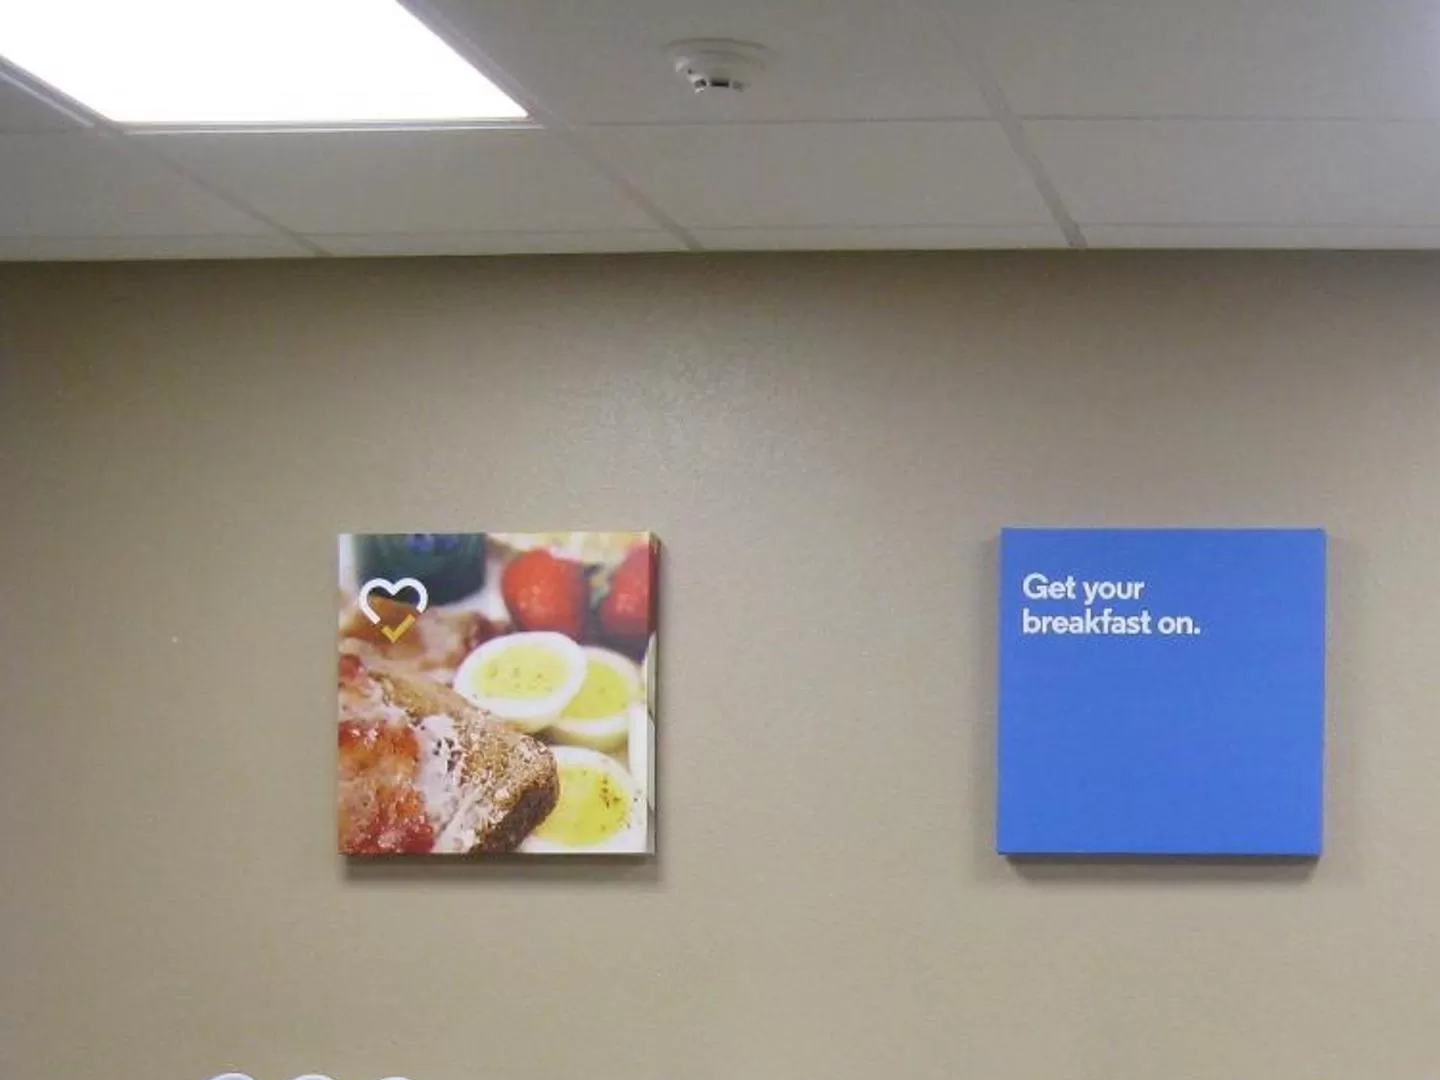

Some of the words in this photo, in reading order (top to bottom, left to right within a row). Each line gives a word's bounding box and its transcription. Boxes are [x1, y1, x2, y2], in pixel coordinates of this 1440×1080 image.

[1022, 572, 1076, 600] Get
[1083, 580, 1145, 605] your
[1022, 608, 1153, 635] breakfast
[1157, 614, 1201, 635] on.
